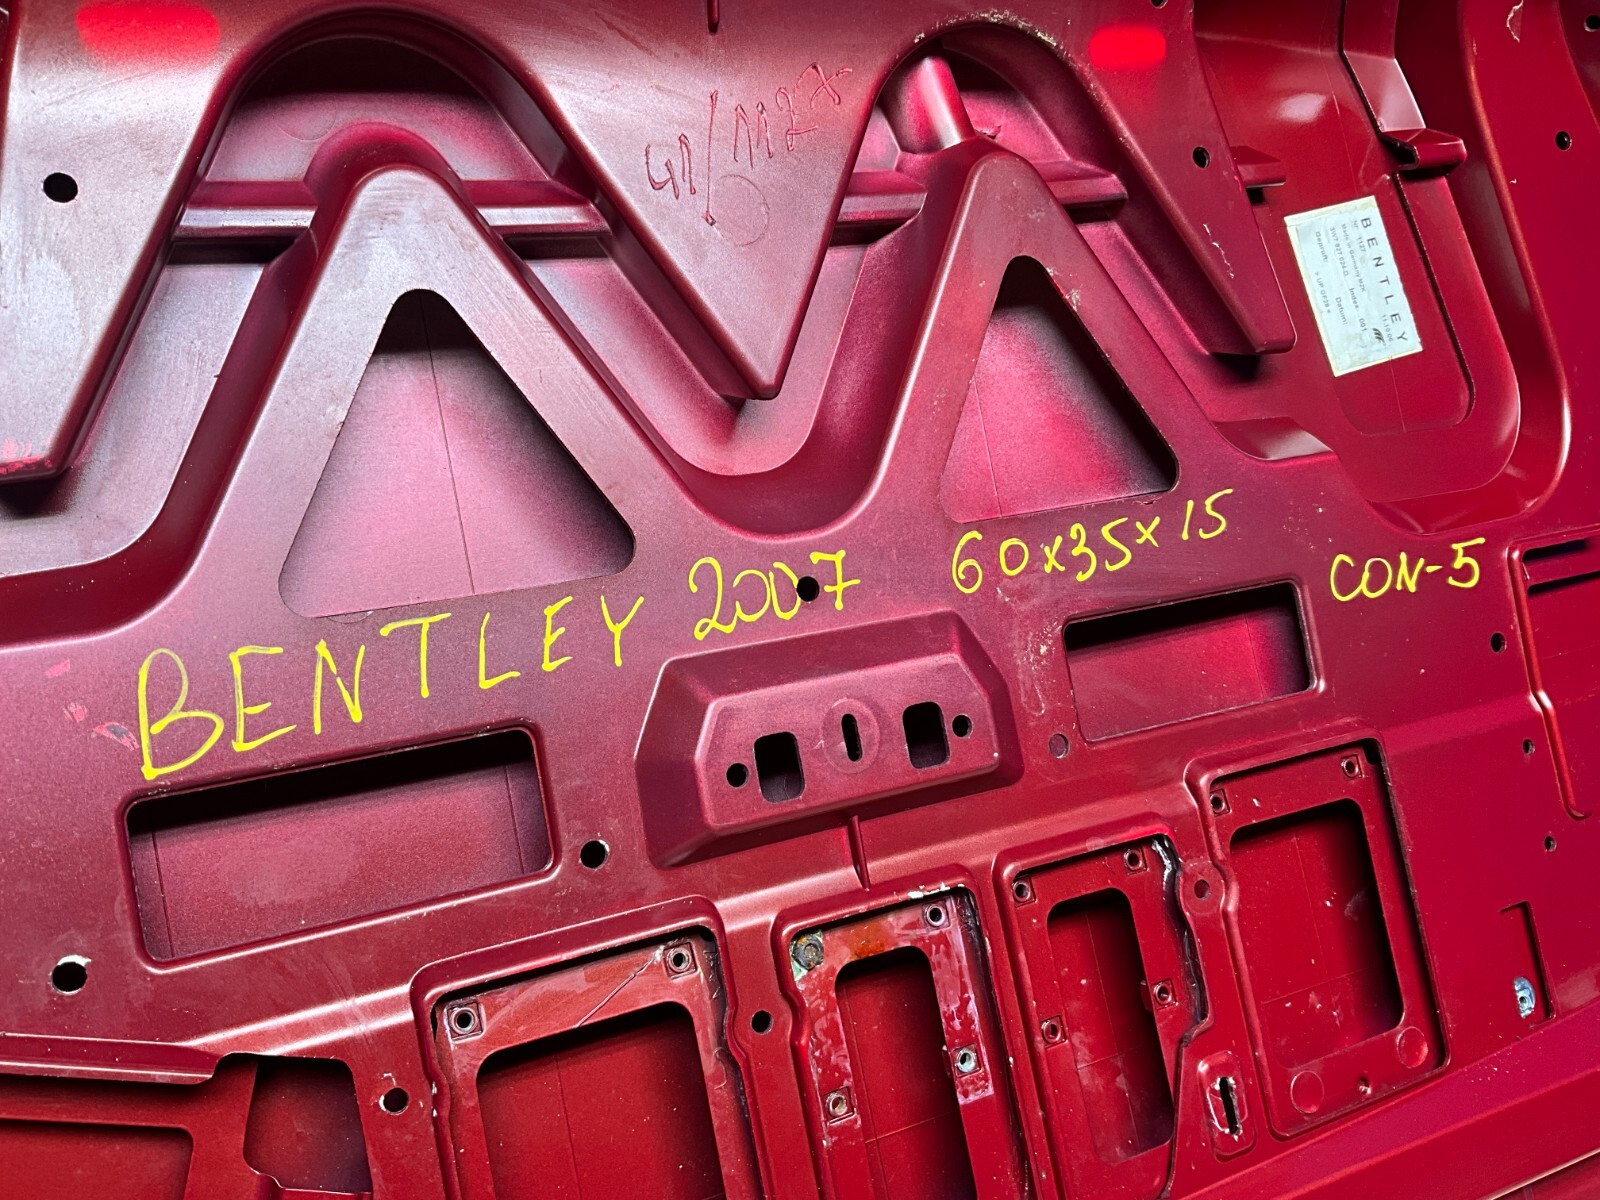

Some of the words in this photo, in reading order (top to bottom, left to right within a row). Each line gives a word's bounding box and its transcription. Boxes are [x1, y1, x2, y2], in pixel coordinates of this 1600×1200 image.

[1340, 223, 1350, 241] Made
[1347, 249, 1362, 277] Germany
[1356, 236, 1366, 252] 1127
[1315, 277, 1324, 288] UP
[1361, 218, 1407, 342] BENTLEY
[1335, 297, 1348, 325] Datum:
[1357, 317, 1367, 332] 001
[1381, 315, 1393, 342] 11.10.06
[1330, 537, 1485, 602] CON-5
[137, 596, 644, 781] BENTLEY
[687, 550, 862, 642] 2007
